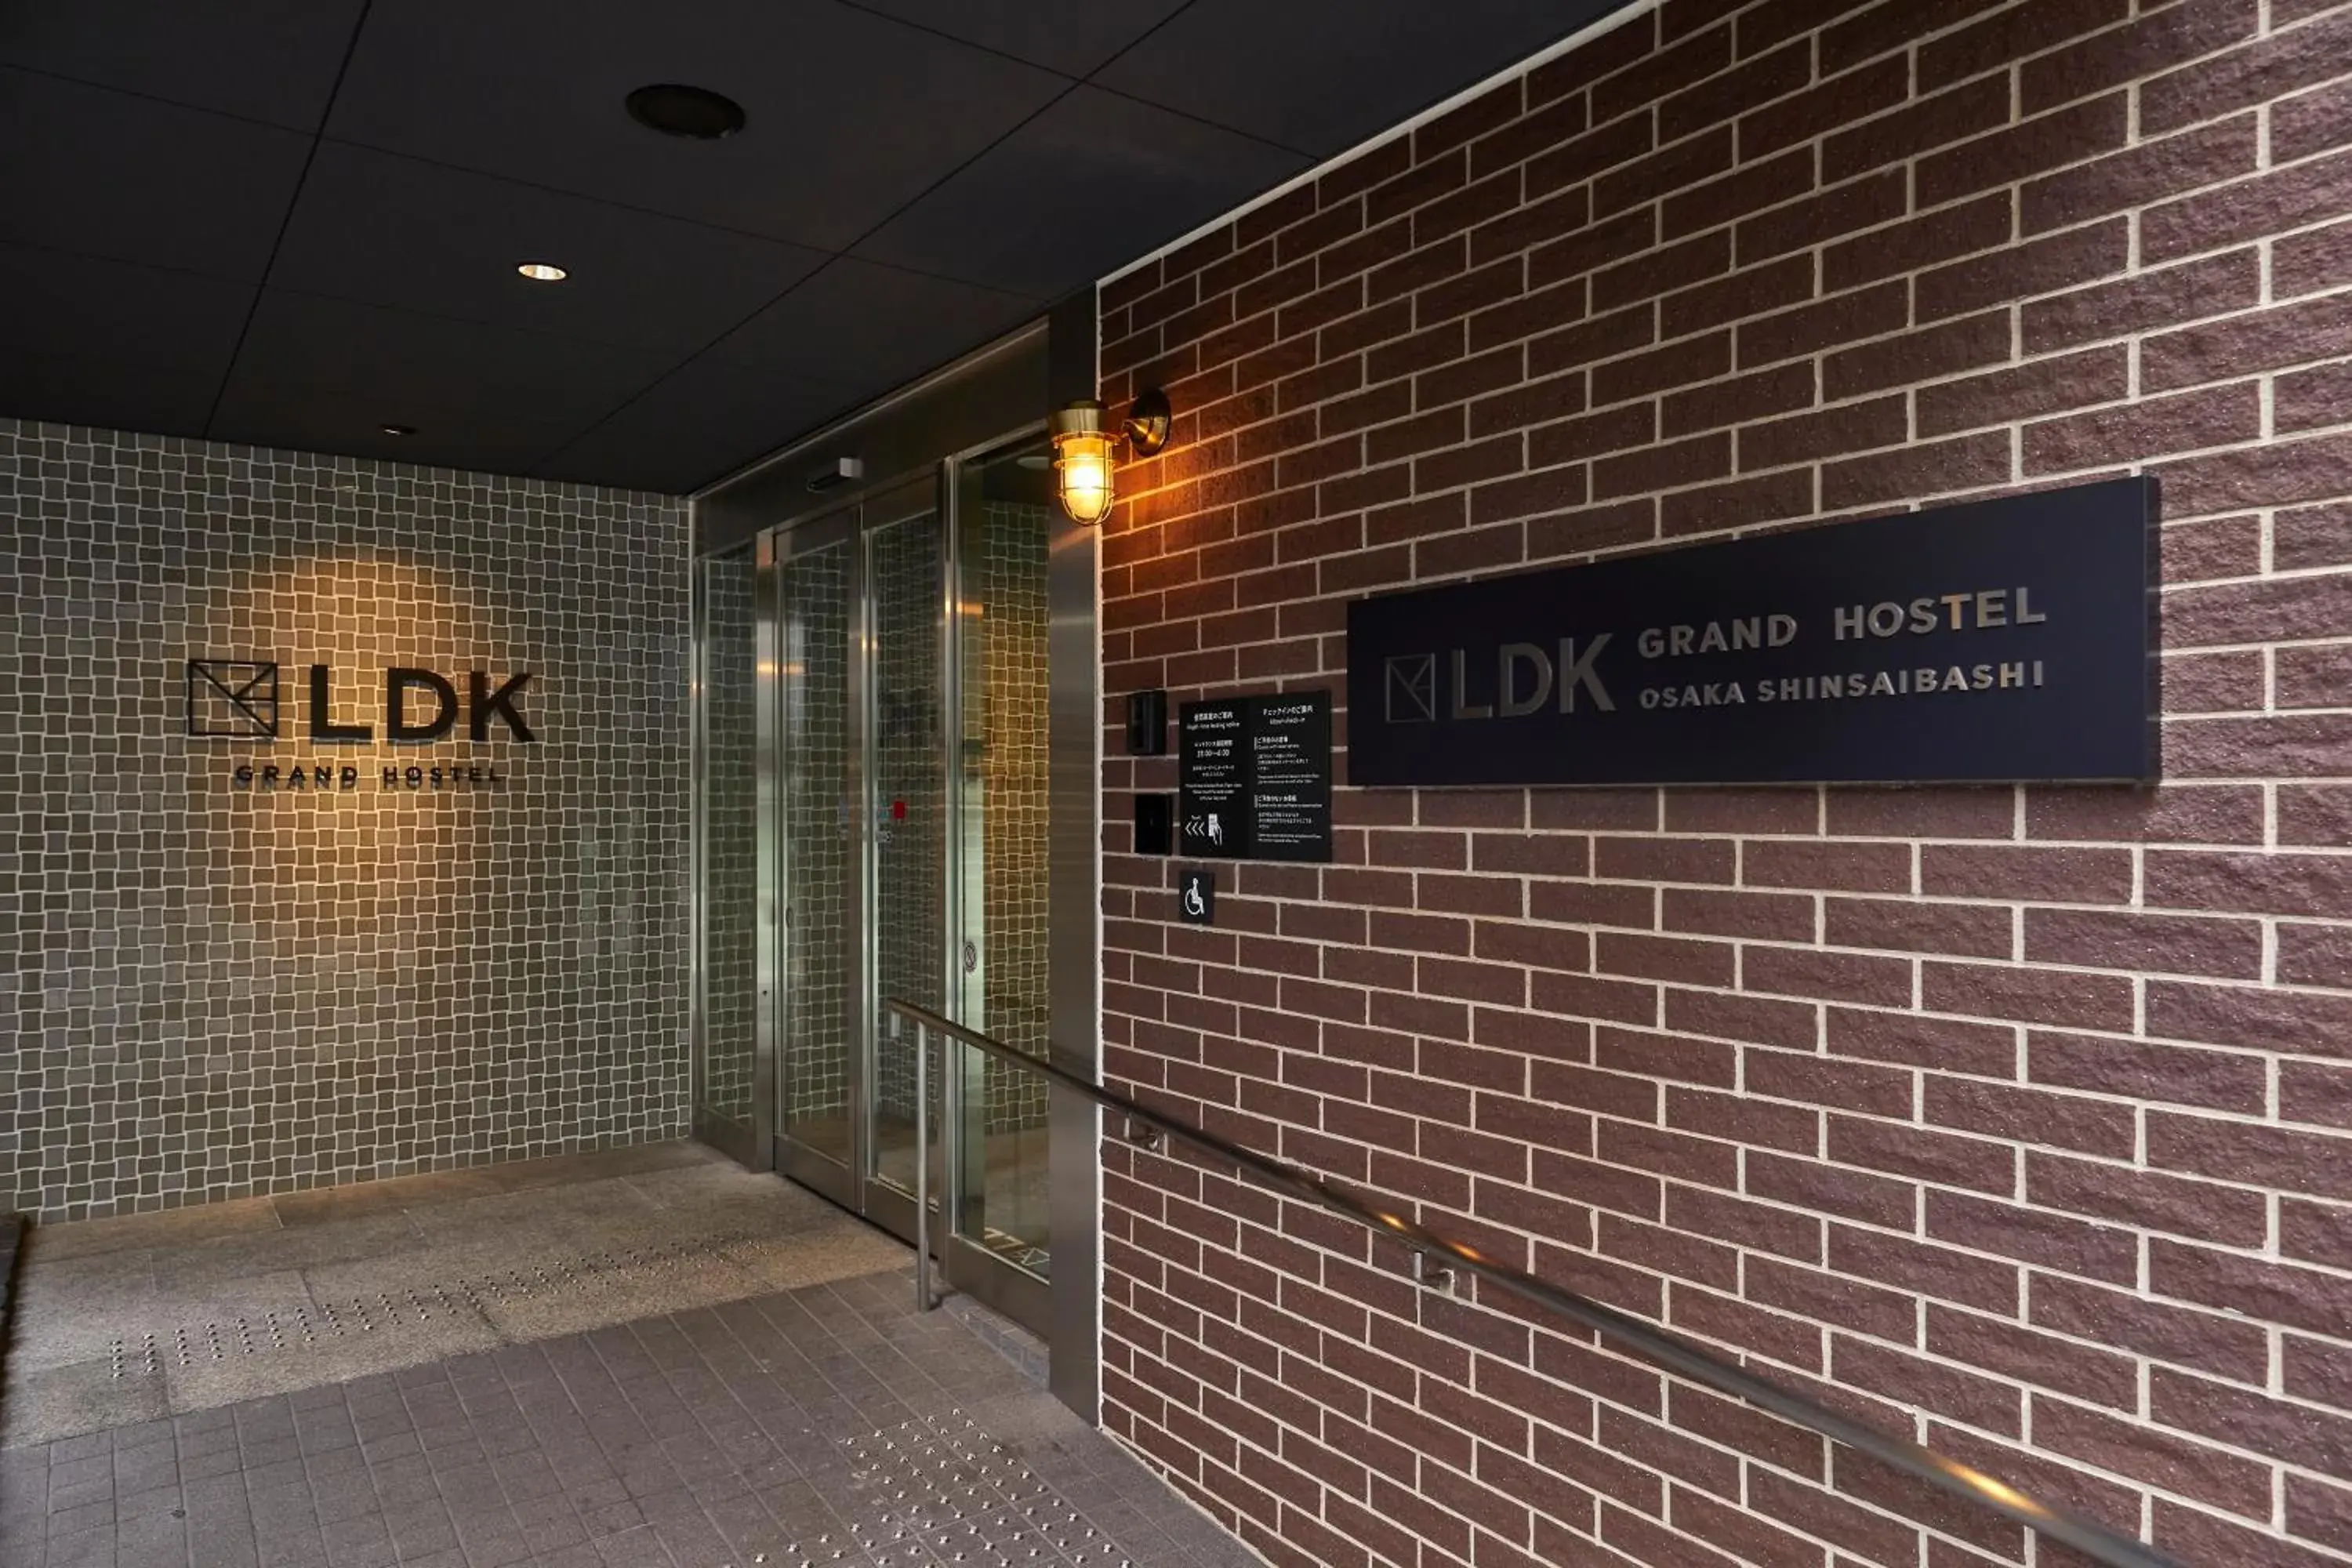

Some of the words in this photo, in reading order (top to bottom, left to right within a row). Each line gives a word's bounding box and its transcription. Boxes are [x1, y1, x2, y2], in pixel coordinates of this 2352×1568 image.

[1638, 614, 1797, 658] GRAND
[1834, 586, 2046, 641] HOSTEL
[310, 664, 535, 742] LDK
[1451, 633, 1617, 719] LDK
[1639, 682, 1745, 709] OSAKA
[1757, 660, 2043, 702] SHINSAIBASHI
[236, 765, 358, 782] GRAND
[383, 766, 502, 782] HOSTEL
